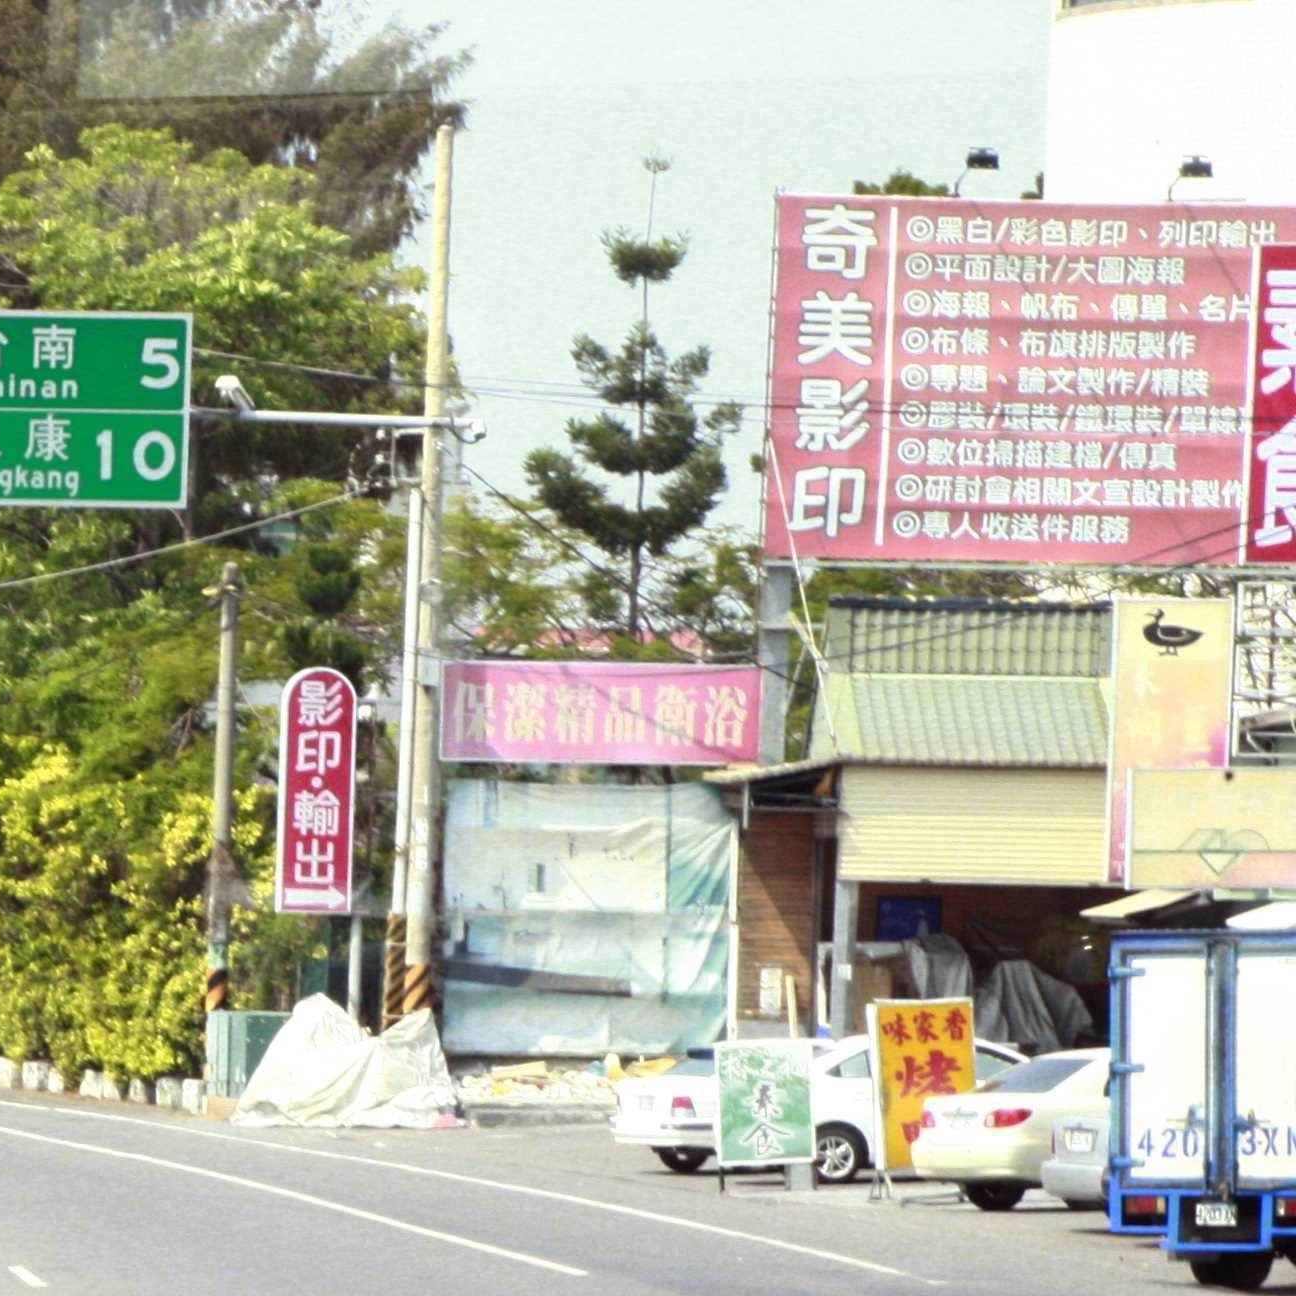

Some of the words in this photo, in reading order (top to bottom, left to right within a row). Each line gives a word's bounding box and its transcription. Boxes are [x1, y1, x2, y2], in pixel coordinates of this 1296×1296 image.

[139, 337, 181, 390] 5
[788, 204, 879, 538] 奇美影印
[96, 429, 176, 481] 10
